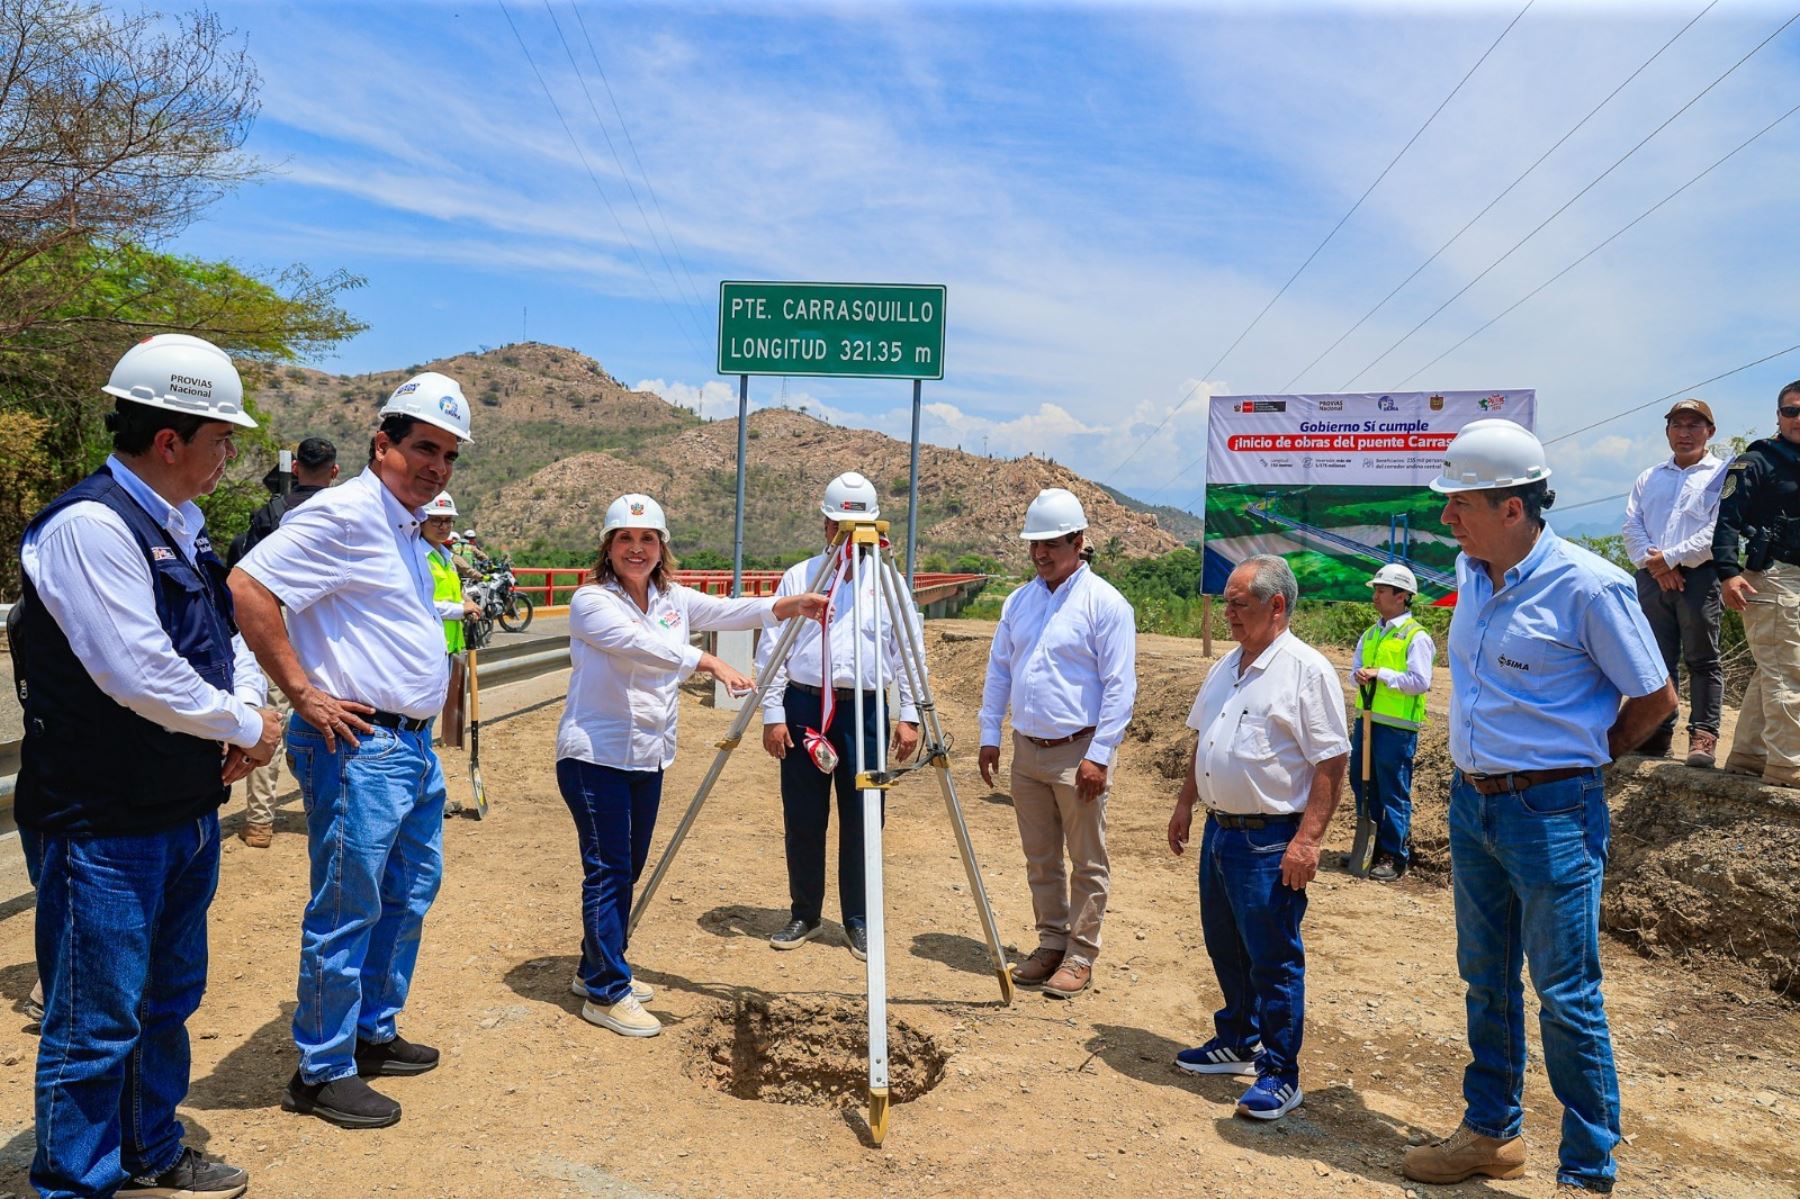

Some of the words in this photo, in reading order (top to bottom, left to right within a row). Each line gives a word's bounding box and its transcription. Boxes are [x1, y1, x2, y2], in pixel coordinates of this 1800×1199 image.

[731, 298, 772, 319] PTE.
[783, 299, 933, 322] CARRASQUILLO
[731, 337, 827, 360] LONGITUD
[840, 340, 902, 362] 321.35
[915, 346, 931, 363] m
[171, 373, 213, 389] PROVIAS
[170, 383, 211, 398] Nacional
[1300, 421, 1360, 432] Gobierno
[1363, 420, 1377, 432] Sí
[1379, 420, 1429, 434] cumple
[1234, 436, 1273, 451] ¡Inicio
[1276, 435, 1292, 448] de
[1295, 436, 1331, 448] obras
[1333, 436, 1355, 448] del
[1357, 437, 1404, 450] puente
[1505, 659, 1529, 671] SIMA
